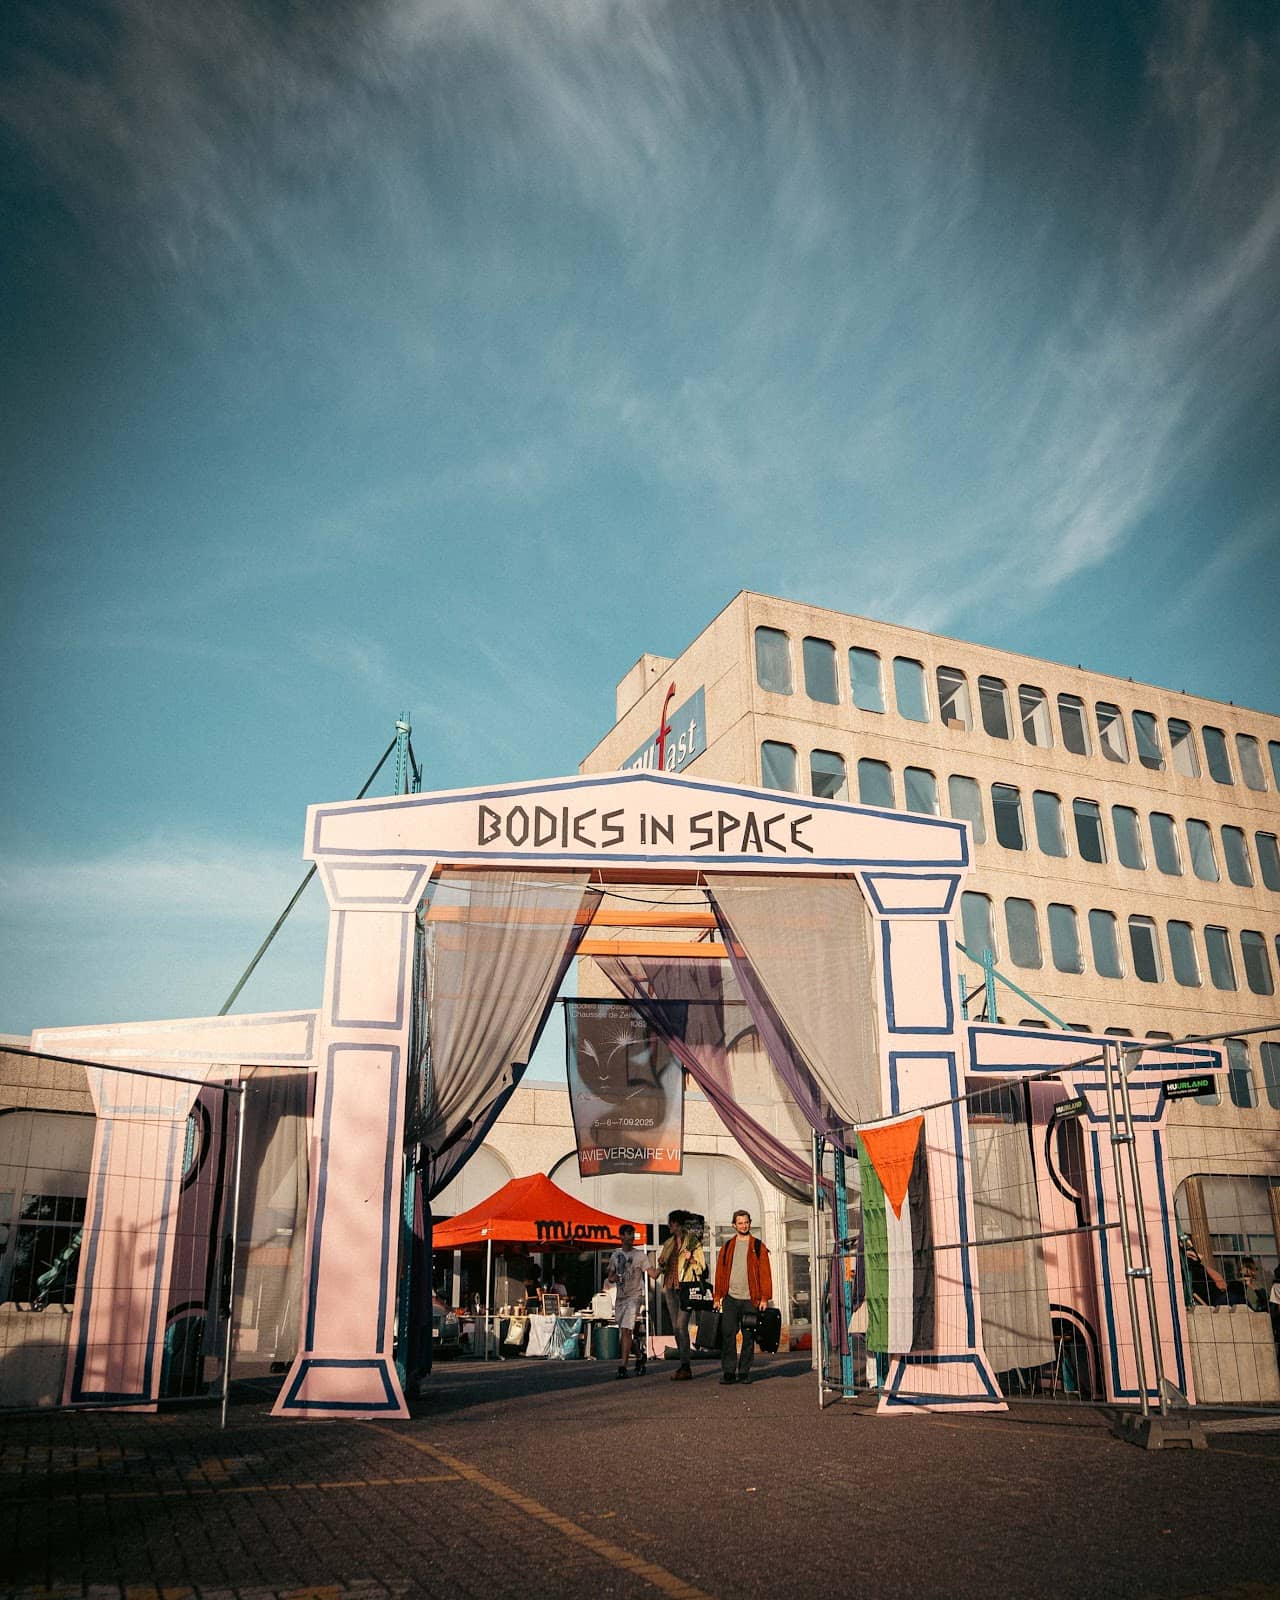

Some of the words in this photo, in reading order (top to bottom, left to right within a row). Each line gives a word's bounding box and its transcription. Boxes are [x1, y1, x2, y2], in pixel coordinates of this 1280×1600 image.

[478, 805, 624, 848] BODIES
[690, 810, 813, 853] SPACE
[1166, 1080, 1209, 1091] HUURLAND
